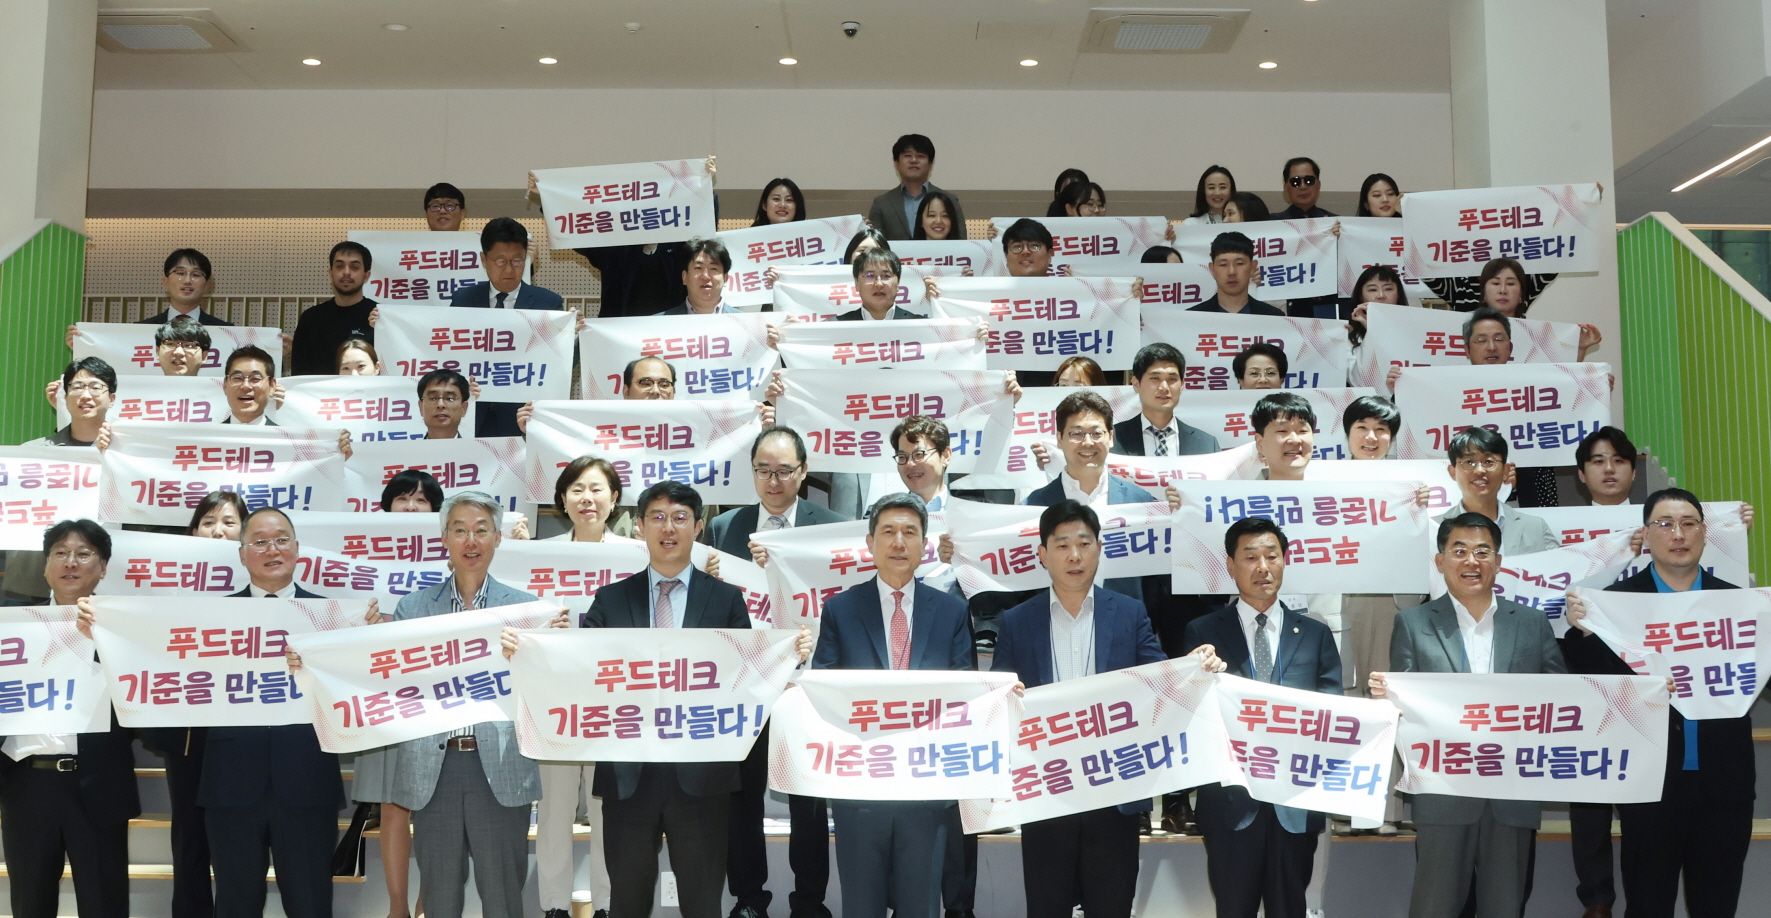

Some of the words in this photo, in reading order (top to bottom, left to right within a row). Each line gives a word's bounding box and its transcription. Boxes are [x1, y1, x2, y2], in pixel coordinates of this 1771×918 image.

[582, 181, 660, 205] 푸드테크
[554, 211, 614, 235] 기준을
[620, 205, 691, 232] 만들다!
[1458, 206, 1543, 231] 푸드테크
[399, 250, 479, 271] 푸드테크
[747, 237, 825, 263] 푸드테크
[1427, 239, 1492, 263] 기준을
[1499, 235, 1576, 261] 만들다!
[370, 278, 430, 300] 기준을
[1140, 282, 1203, 305] 드테크
[989, 298, 1081, 321] 푸드테크
[430, 328, 516, 352] 푸드테크
[640, 335, 732, 360] 푸드테크
[832, 340, 925, 365] 푸드테크
[985, 331, 1025, 354] 준을
[1032, 330, 1113, 355] 만들다!
[1184, 366, 1230, 390] 준을
[119, 399, 213, 423] 푸드테크
[318, 398, 412, 421] 푸드테크
[844, 393, 946, 420] 푸드테크
[1461, 386, 1562, 415] 푸드테크
[594, 423, 695, 450] 푸드테크
[807, 428, 883, 457] 기준을
[173, 444, 275, 473] 푸드테크
[341, 535, 450, 562] 푸드테크
[980, 543, 1040, 576] 기준
[1102, 527, 1171, 559] 들다!
[125, 558, 235, 592] 푸드테크
[296, 556, 379, 591] 기준을
[527, 568, 634, 598] 푸드테
[167, 627, 289, 660] 푸드테크
[370, 638, 492, 680] 푸드테크
[118, 671, 215, 705] 기준을
[594, 658, 720, 692] 푸드테크
[0, 679, 75, 713] 들다!
[333, 686, 425, 728] 기준을
[548, 704, 643, 738] 기준을
[654, 703, 763, 739] 만들다!
[848, 699, 972, 733] 푸드테크
[1017, 700, 1139, 751] 푸드테크
[1236, 698, 1361, 746] 푸드테크
[1459, 703, 1584, 735] 푸드테크
[805, 742, 897, 778] 기준을
[908, 741, 1010, 778] 만들다
[1012, 759, 1074, 801] 준을
[1082, 732, 1189, 786] 만들다!
[1411, 741, 1505, 777] 기준을
[1515, 746, 1628, 781] 만들다!
[1290, 753, 1388, 799] 만들다
